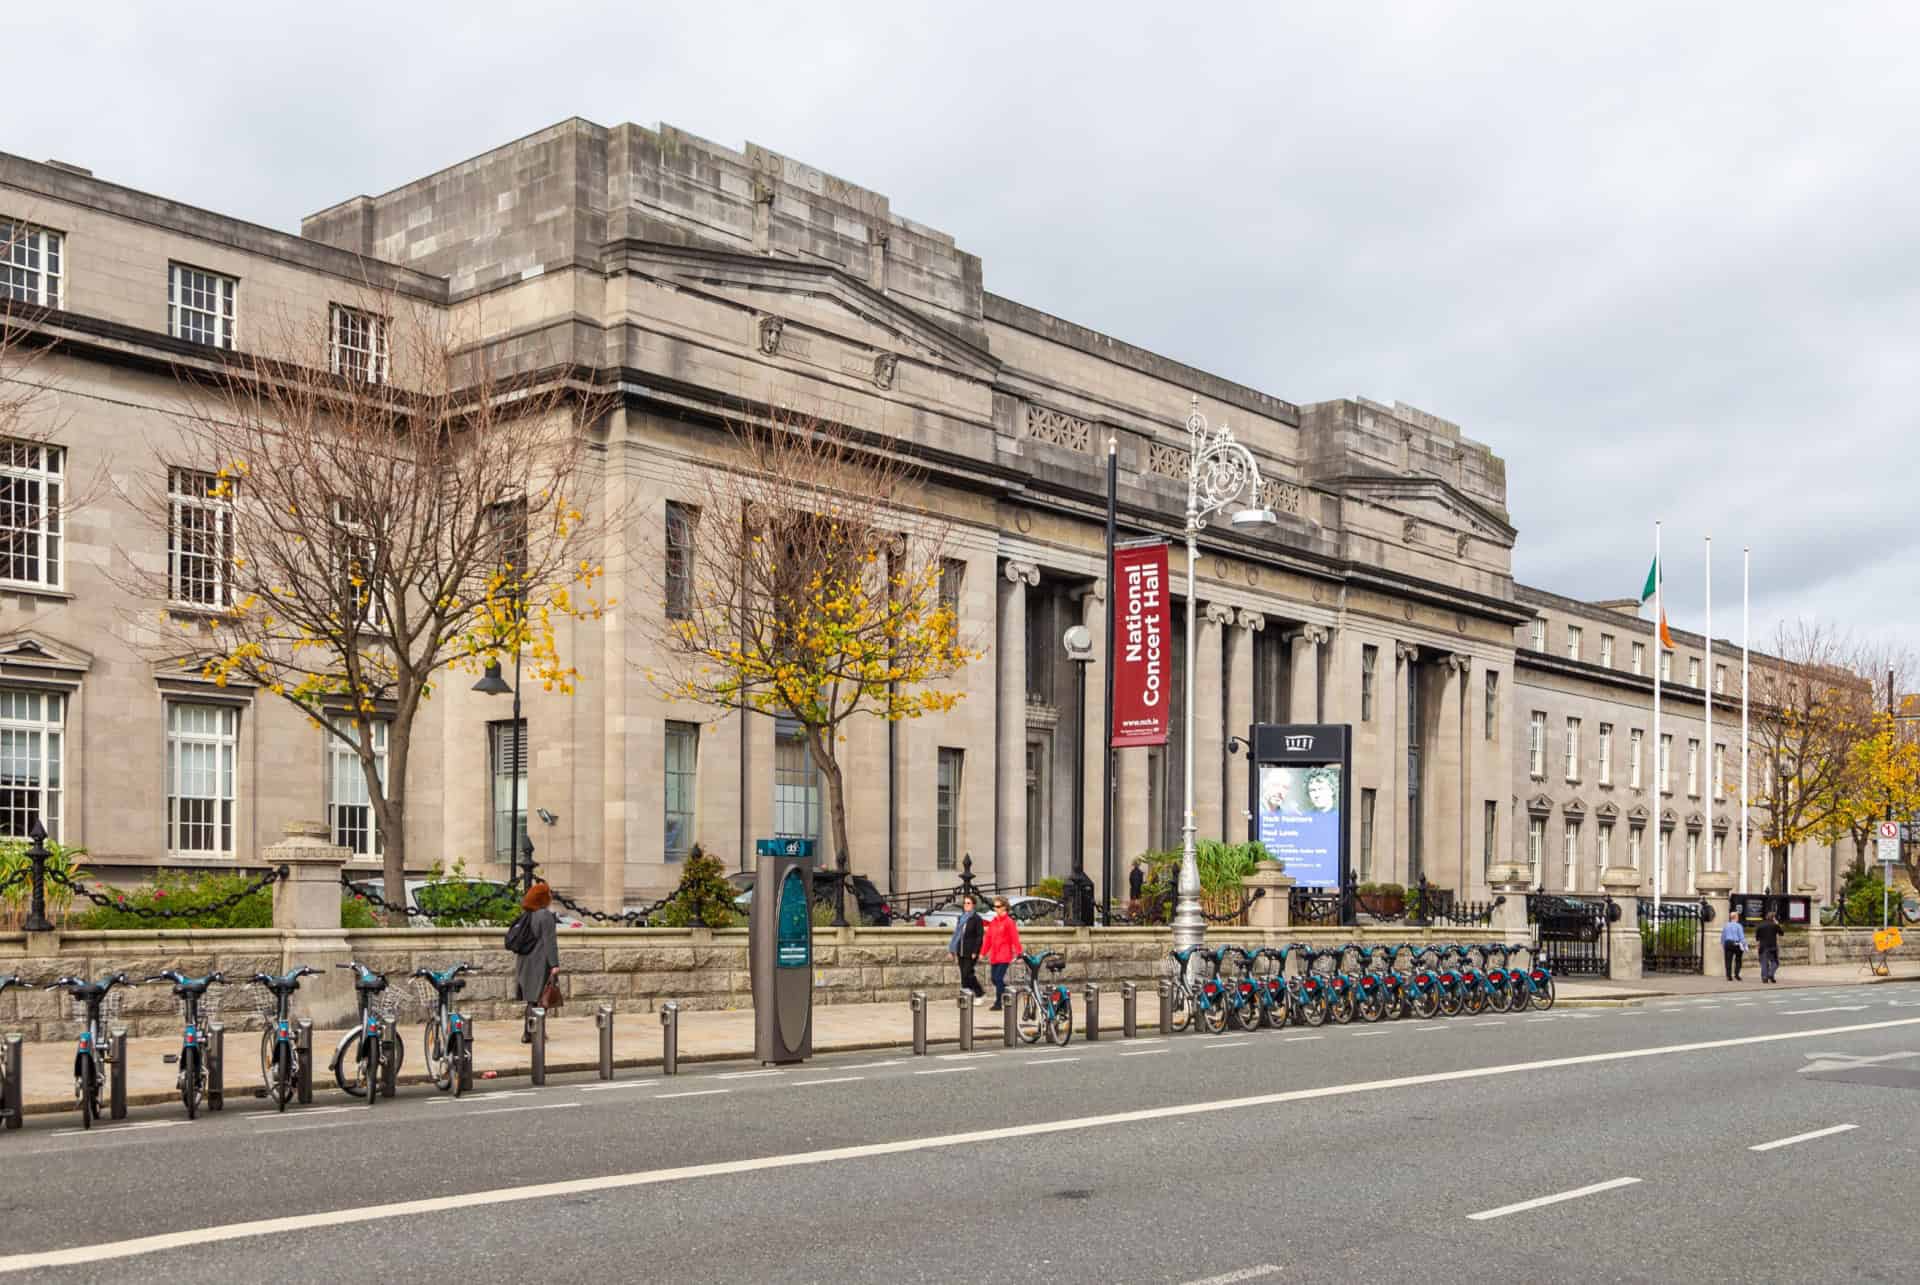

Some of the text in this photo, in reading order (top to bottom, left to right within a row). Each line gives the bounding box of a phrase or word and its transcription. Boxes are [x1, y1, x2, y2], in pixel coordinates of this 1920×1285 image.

[1124, 564, 1142, 662] National
[1142, 562, 1160, 706] Concert Hall
